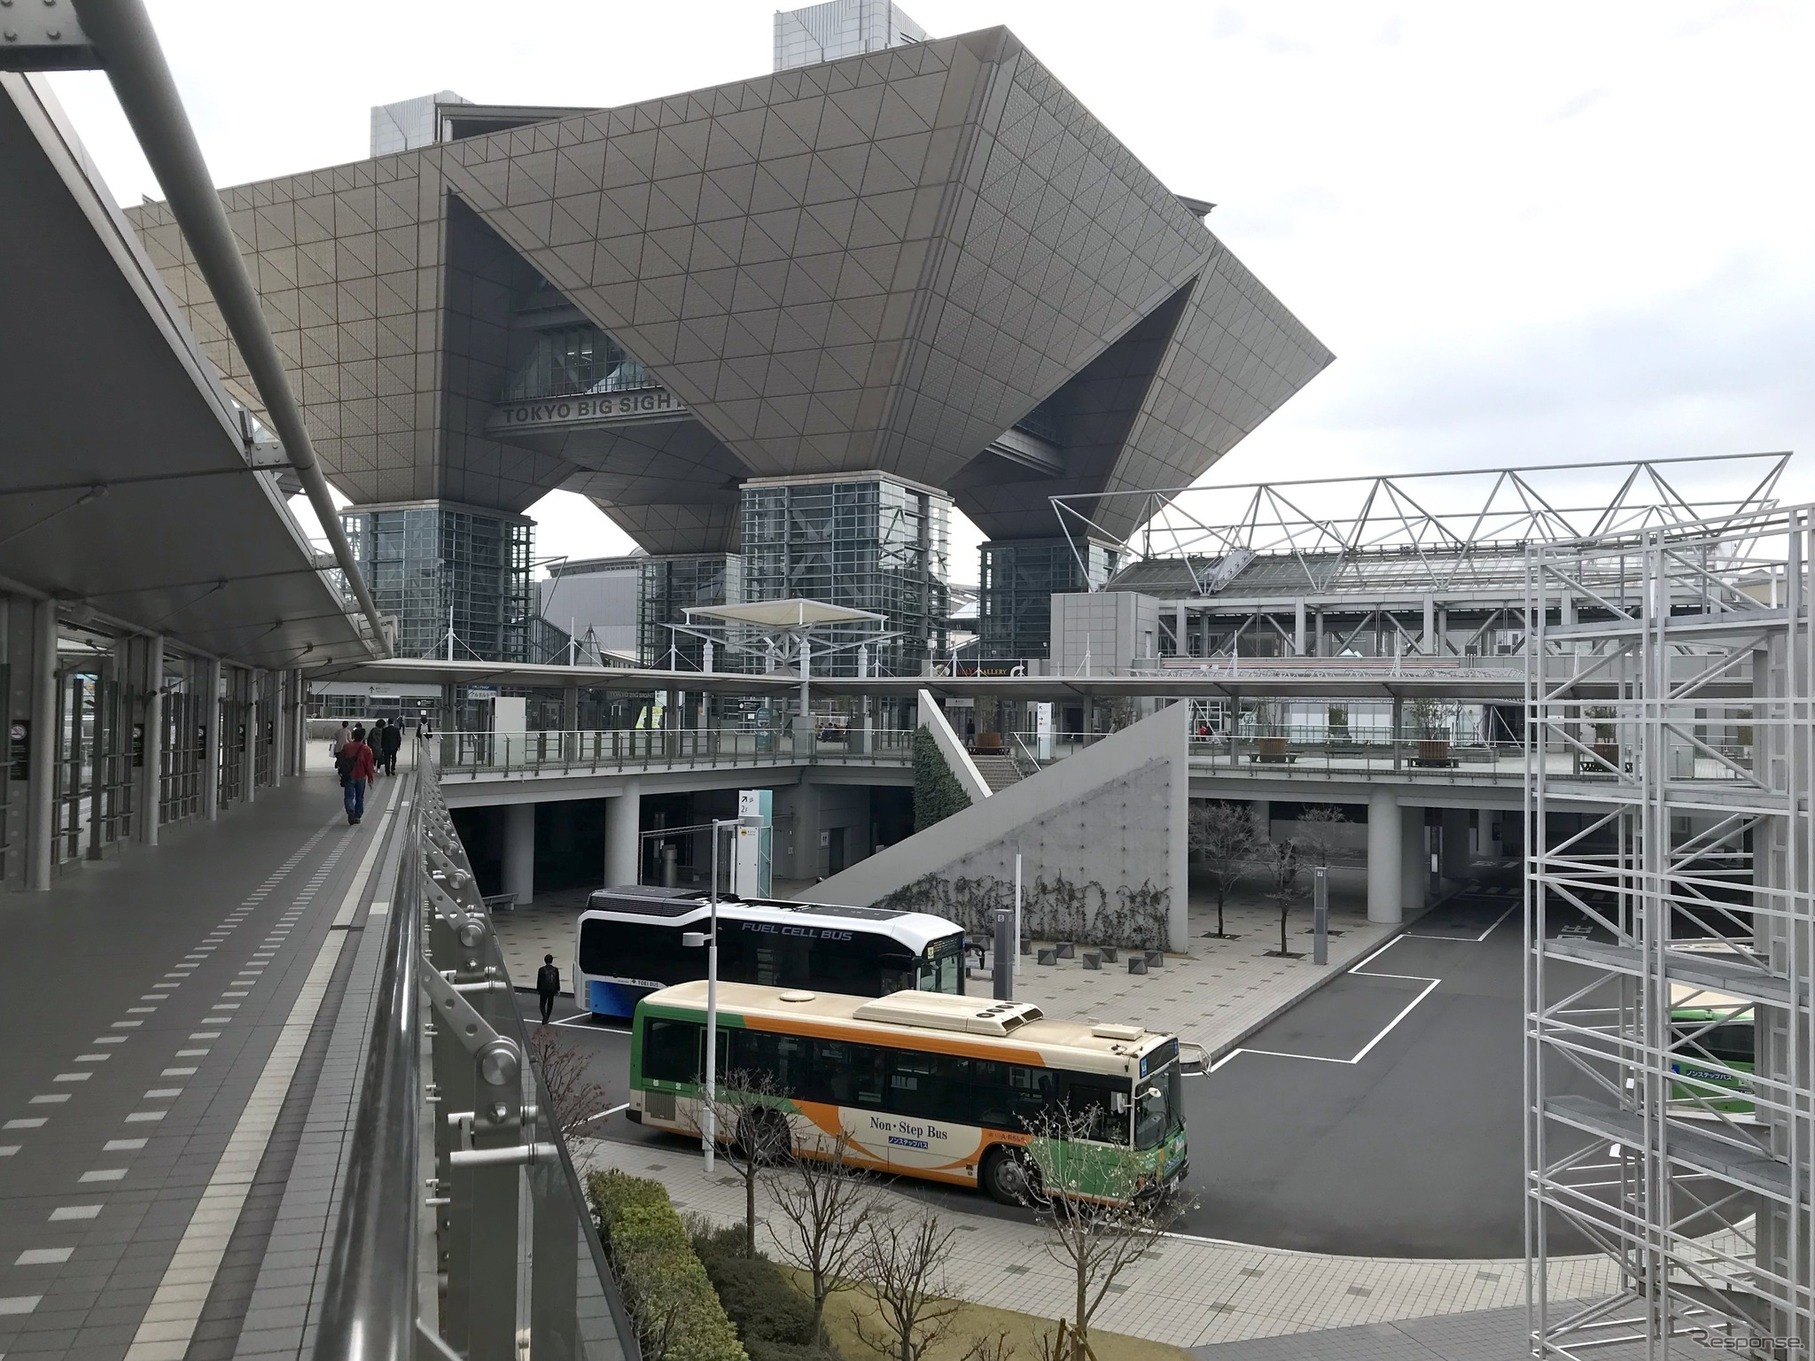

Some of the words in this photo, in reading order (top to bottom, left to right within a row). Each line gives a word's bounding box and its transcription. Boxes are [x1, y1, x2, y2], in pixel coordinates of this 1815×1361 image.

[503, 403, 571, 423] TOKYO
[578, 399, 613, 416] BIG
[619, 393, 682, 412] SIGH
[741, 922, 778, 934] FUEL
[781, 926, 817, 938] CELL
[820, 930, 853, 941] BUS
[928, 1125, 948, 1140] Bus
[889, 1137, 928, 1148] ノンステップバス
